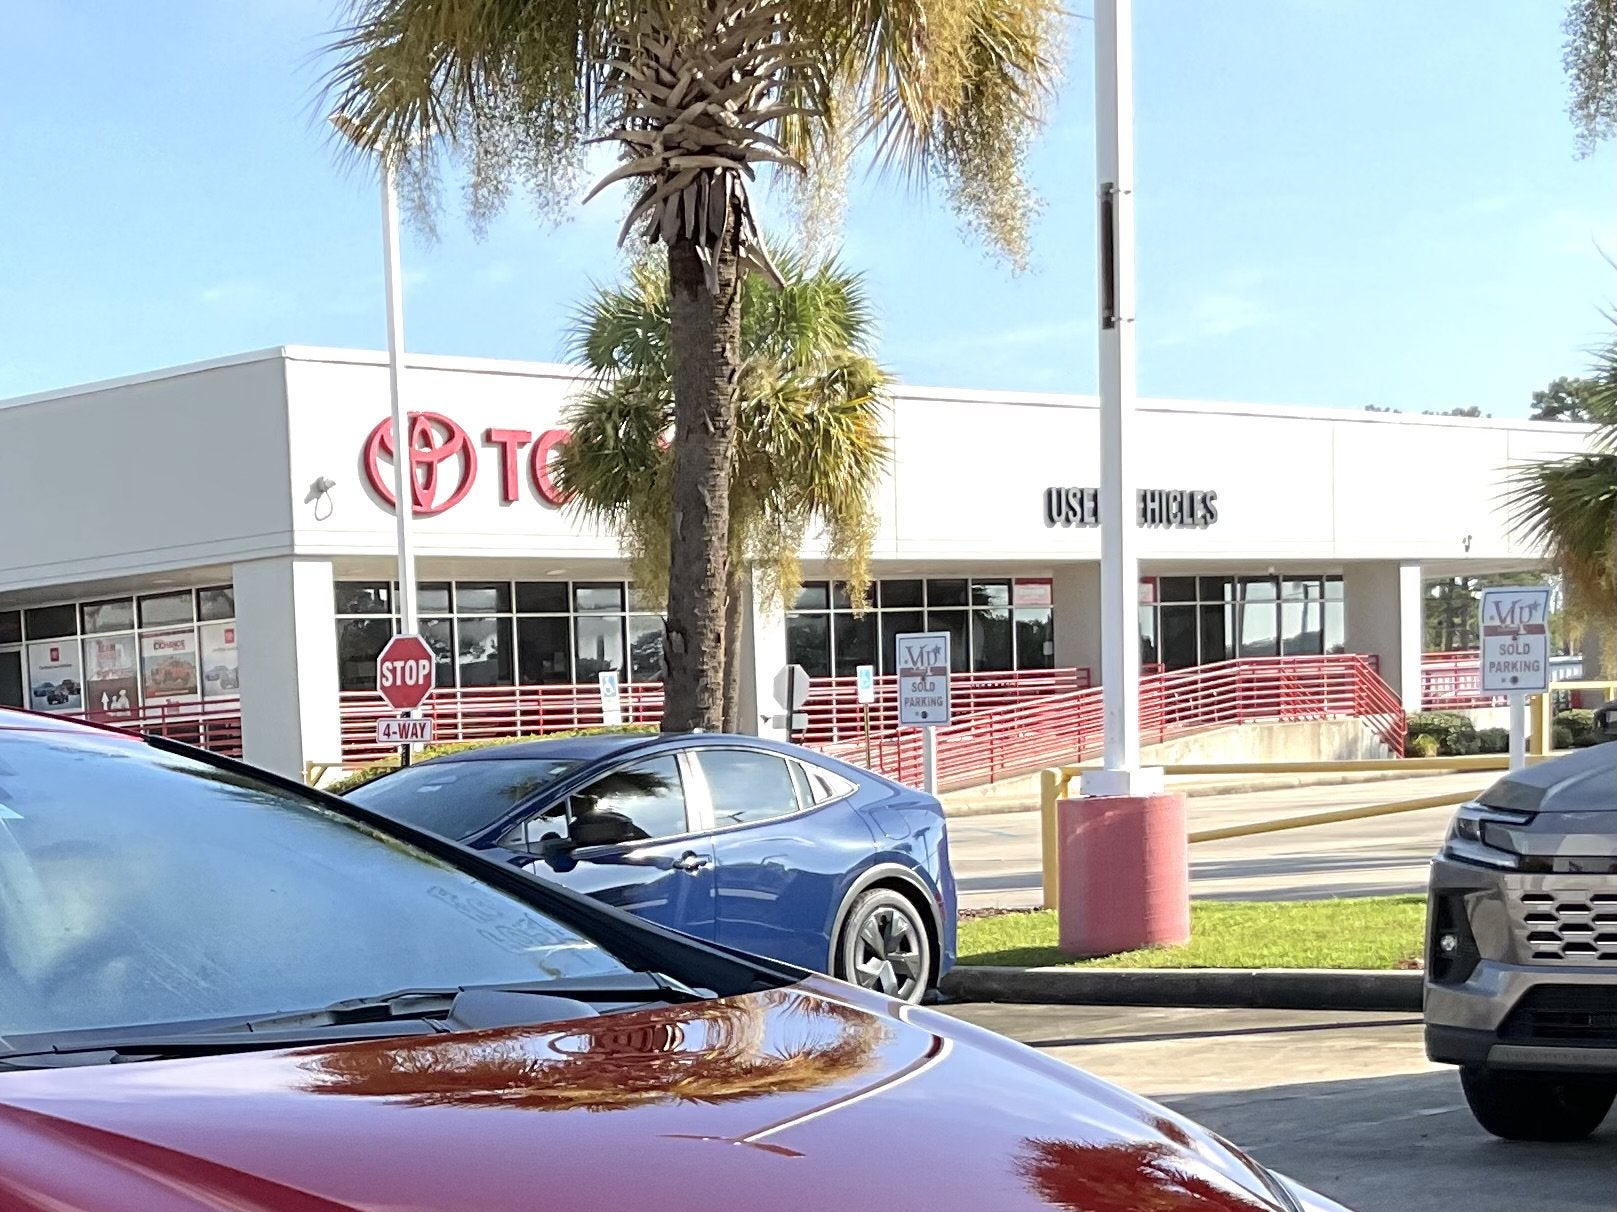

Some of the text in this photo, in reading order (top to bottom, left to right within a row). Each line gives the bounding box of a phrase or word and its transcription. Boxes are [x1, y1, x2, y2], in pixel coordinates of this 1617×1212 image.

[1044, 487, 1218, 530] USE EHICLES
[1499, 643, 1531, 656] SOLD
[1488, 660, 1540, 673] PARKING
[382, 659, 430, 688] STOP
[911, 681, 936, 693] SOLD
[904, 696, 943, 707] PARKING
[383, 722, 426, 740] 4-WAY
